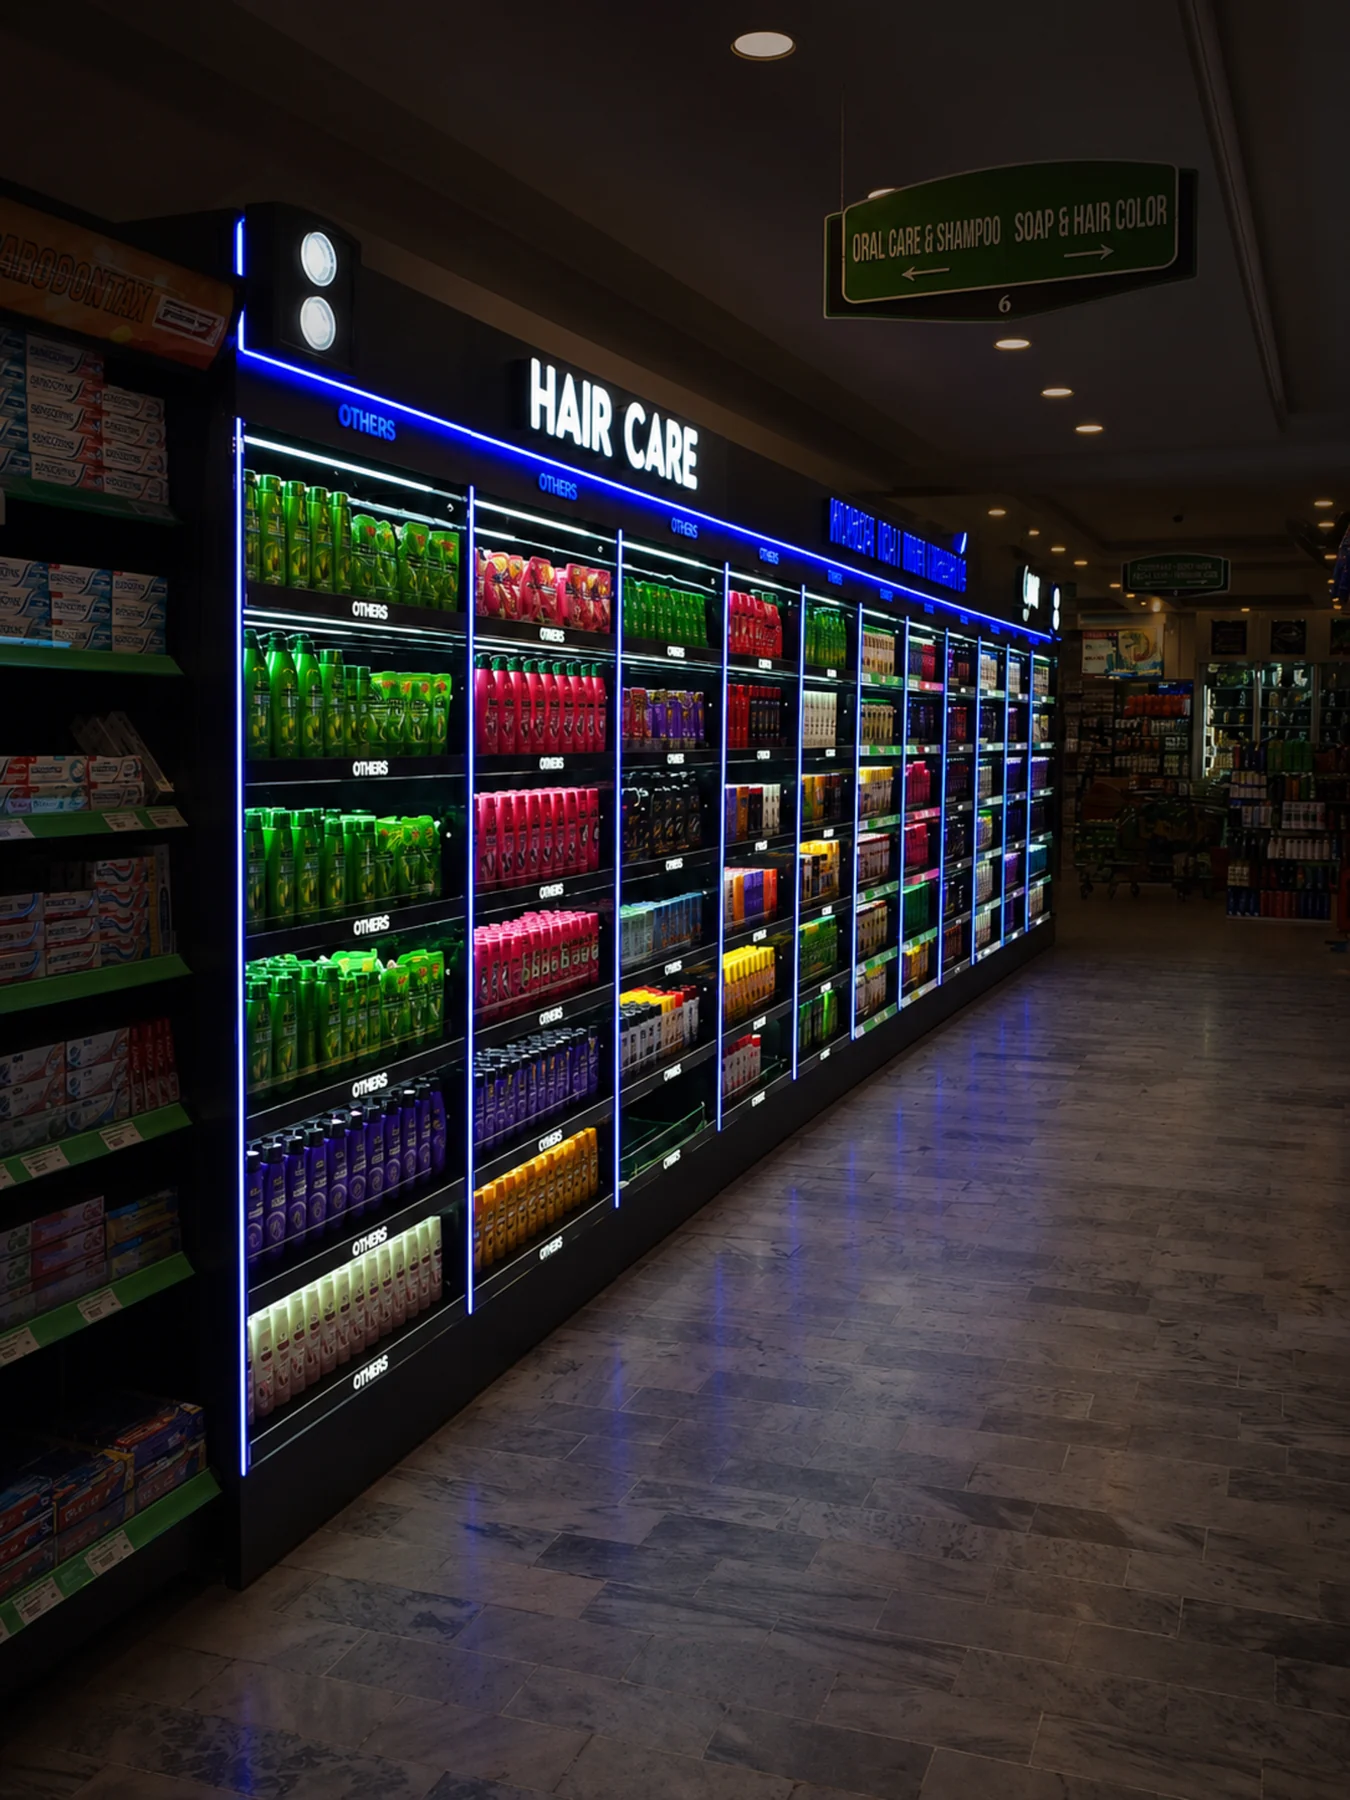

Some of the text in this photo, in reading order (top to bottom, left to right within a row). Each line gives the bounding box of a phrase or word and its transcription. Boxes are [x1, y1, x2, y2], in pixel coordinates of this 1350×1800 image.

[852, 194, 1168, 263] ORAL CARE & SHAMPOO SOAP & HAIR COLOR
[0, 233, 153, 323] ARODONTAX
[998, 294, 1012, 314] 6
[338, 403, 396, 442] OTHERS
[530, 356, 699, 491] HAIR CARE
[538, 472, 578, 501] OTHERS
[670, 517, 699, 540] OTHERS
[352, 600, 389, 621] OTHERS
[352, 760, 389, 777] OTHERS
[353, 915, 390, 936] OTHERS
[351, 1073, 388, 1098] OTHERS
[351, 1226, 388, 1257] OTHERS
[353, 1355, 389, 1390] OTHERS
